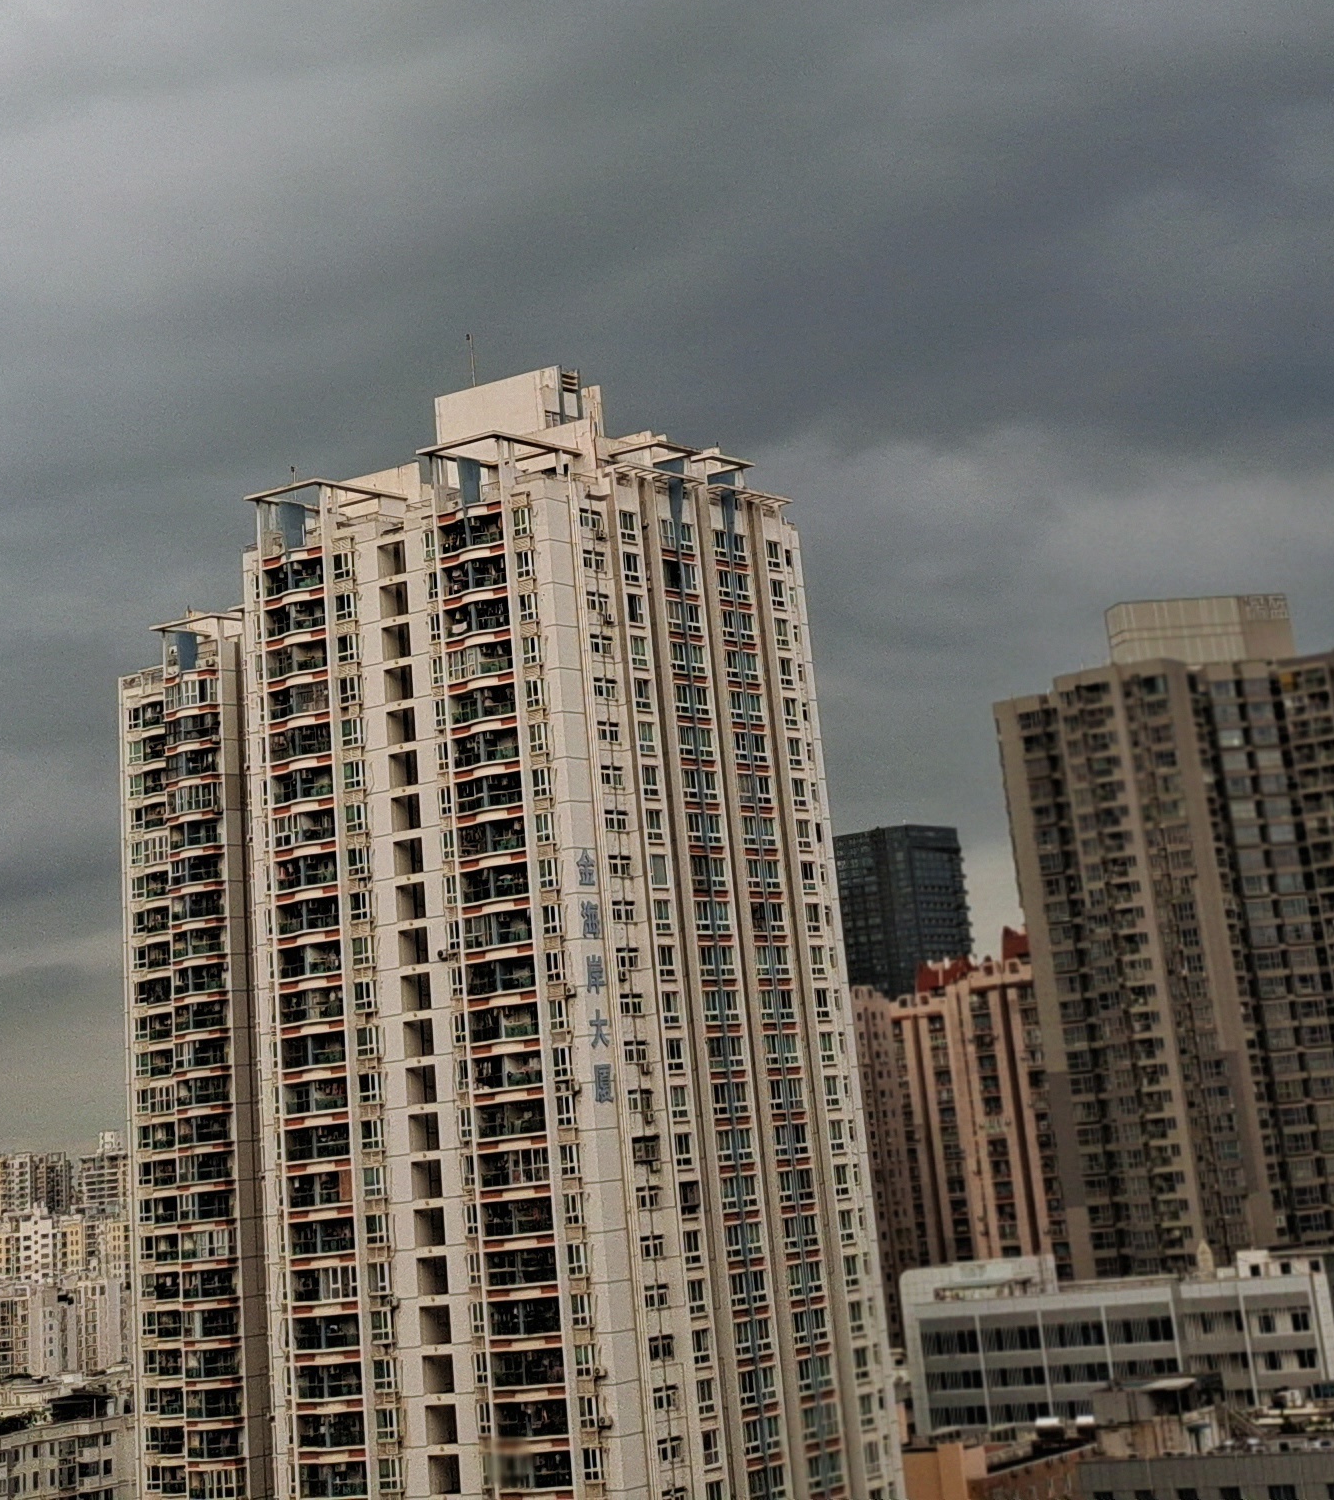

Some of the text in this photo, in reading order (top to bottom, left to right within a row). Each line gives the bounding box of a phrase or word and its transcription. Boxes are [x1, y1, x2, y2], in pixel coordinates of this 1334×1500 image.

[576, 847, 615, 1105] 金海岸大厦
